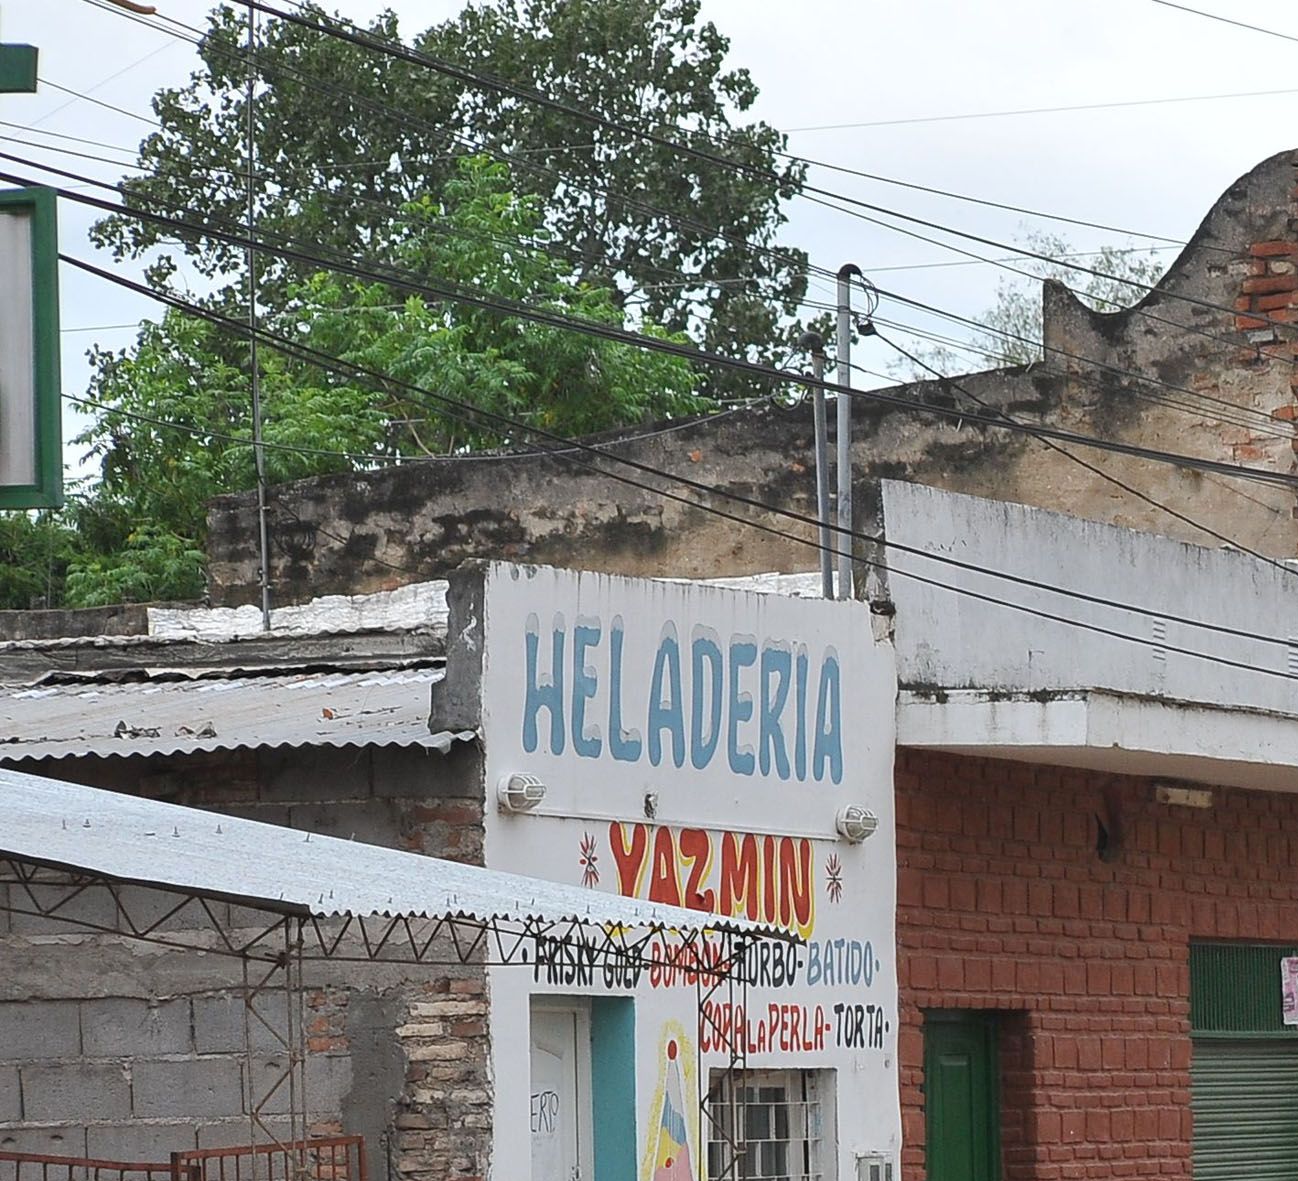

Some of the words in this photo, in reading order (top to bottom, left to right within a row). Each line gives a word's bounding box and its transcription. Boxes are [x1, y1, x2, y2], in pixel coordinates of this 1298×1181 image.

[523, 611, 843, 784] HELADERIA
[608, 820, 815, 938] YAZMIN
[534, 935, 596, 987] FRISKY
[734, 940, 798, 988] TURBO
[807, 938, 873, 988] BATIDO
[701, 1000, 745, 1054] COPA
[768, 1003, 825, 1052] PERLA
[834, 1003, 883, 1049] TORTA
